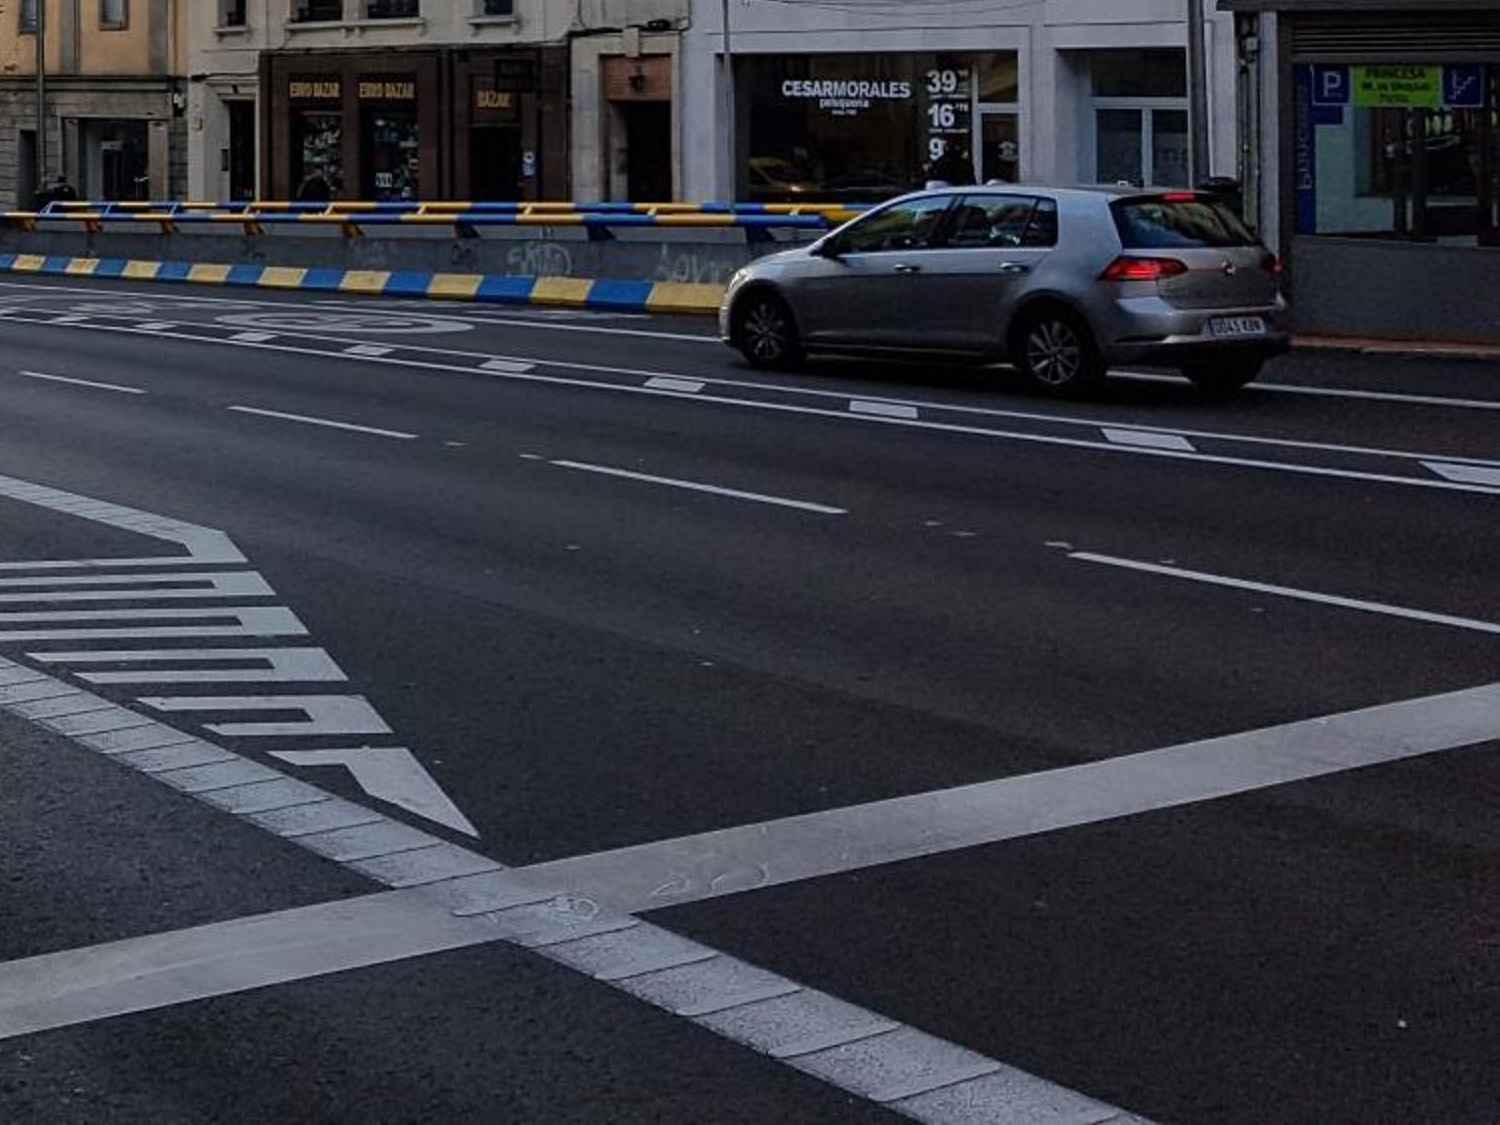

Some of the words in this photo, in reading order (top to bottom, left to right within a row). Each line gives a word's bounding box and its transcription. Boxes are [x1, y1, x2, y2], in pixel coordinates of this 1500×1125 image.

[781, 79, 911, 99] CESARMORALES
[926, 70, 957, 93] 39
[1323, 71, 1341, 97] P
[927, 103, 955, 127] 16
